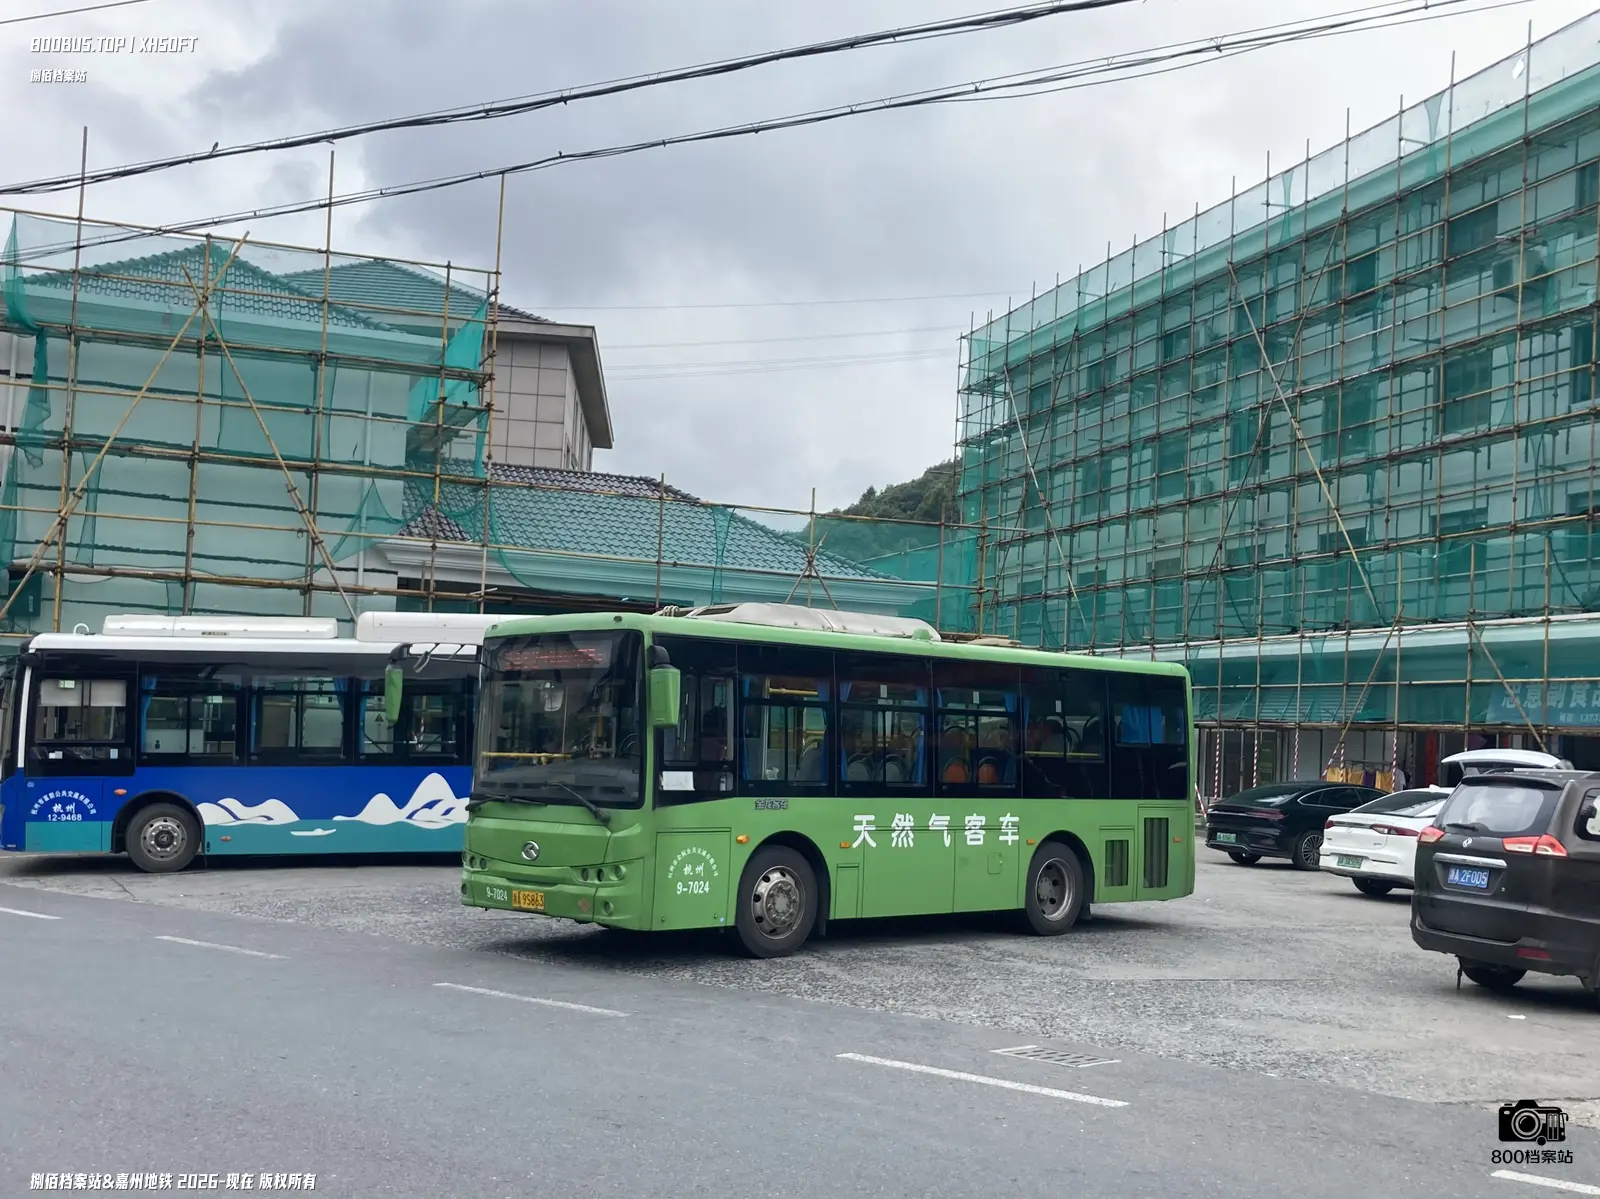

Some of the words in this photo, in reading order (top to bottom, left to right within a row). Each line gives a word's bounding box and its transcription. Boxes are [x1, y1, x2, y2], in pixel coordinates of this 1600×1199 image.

[47, 813, 82, 822] 12-9468
[852, 812, 1020, 848] 天然气客车
[486, 886, 508, 902] 9-7024
[676, 880, 710, 895] 9-7024
